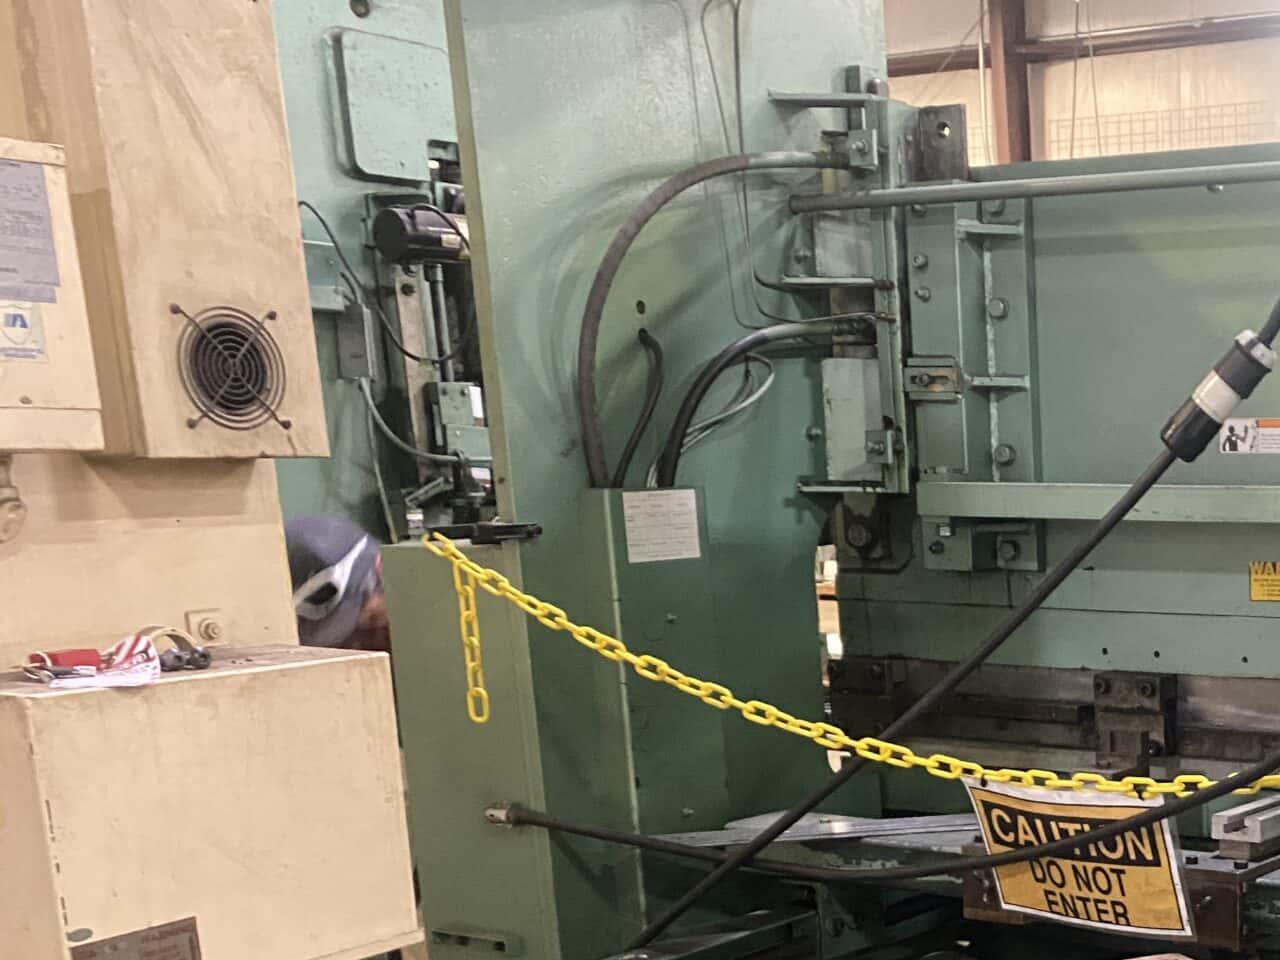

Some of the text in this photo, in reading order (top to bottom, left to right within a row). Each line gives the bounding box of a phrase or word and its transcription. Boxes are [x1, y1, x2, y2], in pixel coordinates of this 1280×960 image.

[1029, 858, 1127, 897] DO NOT
[1044, 889, 1131, 926] ENTER
